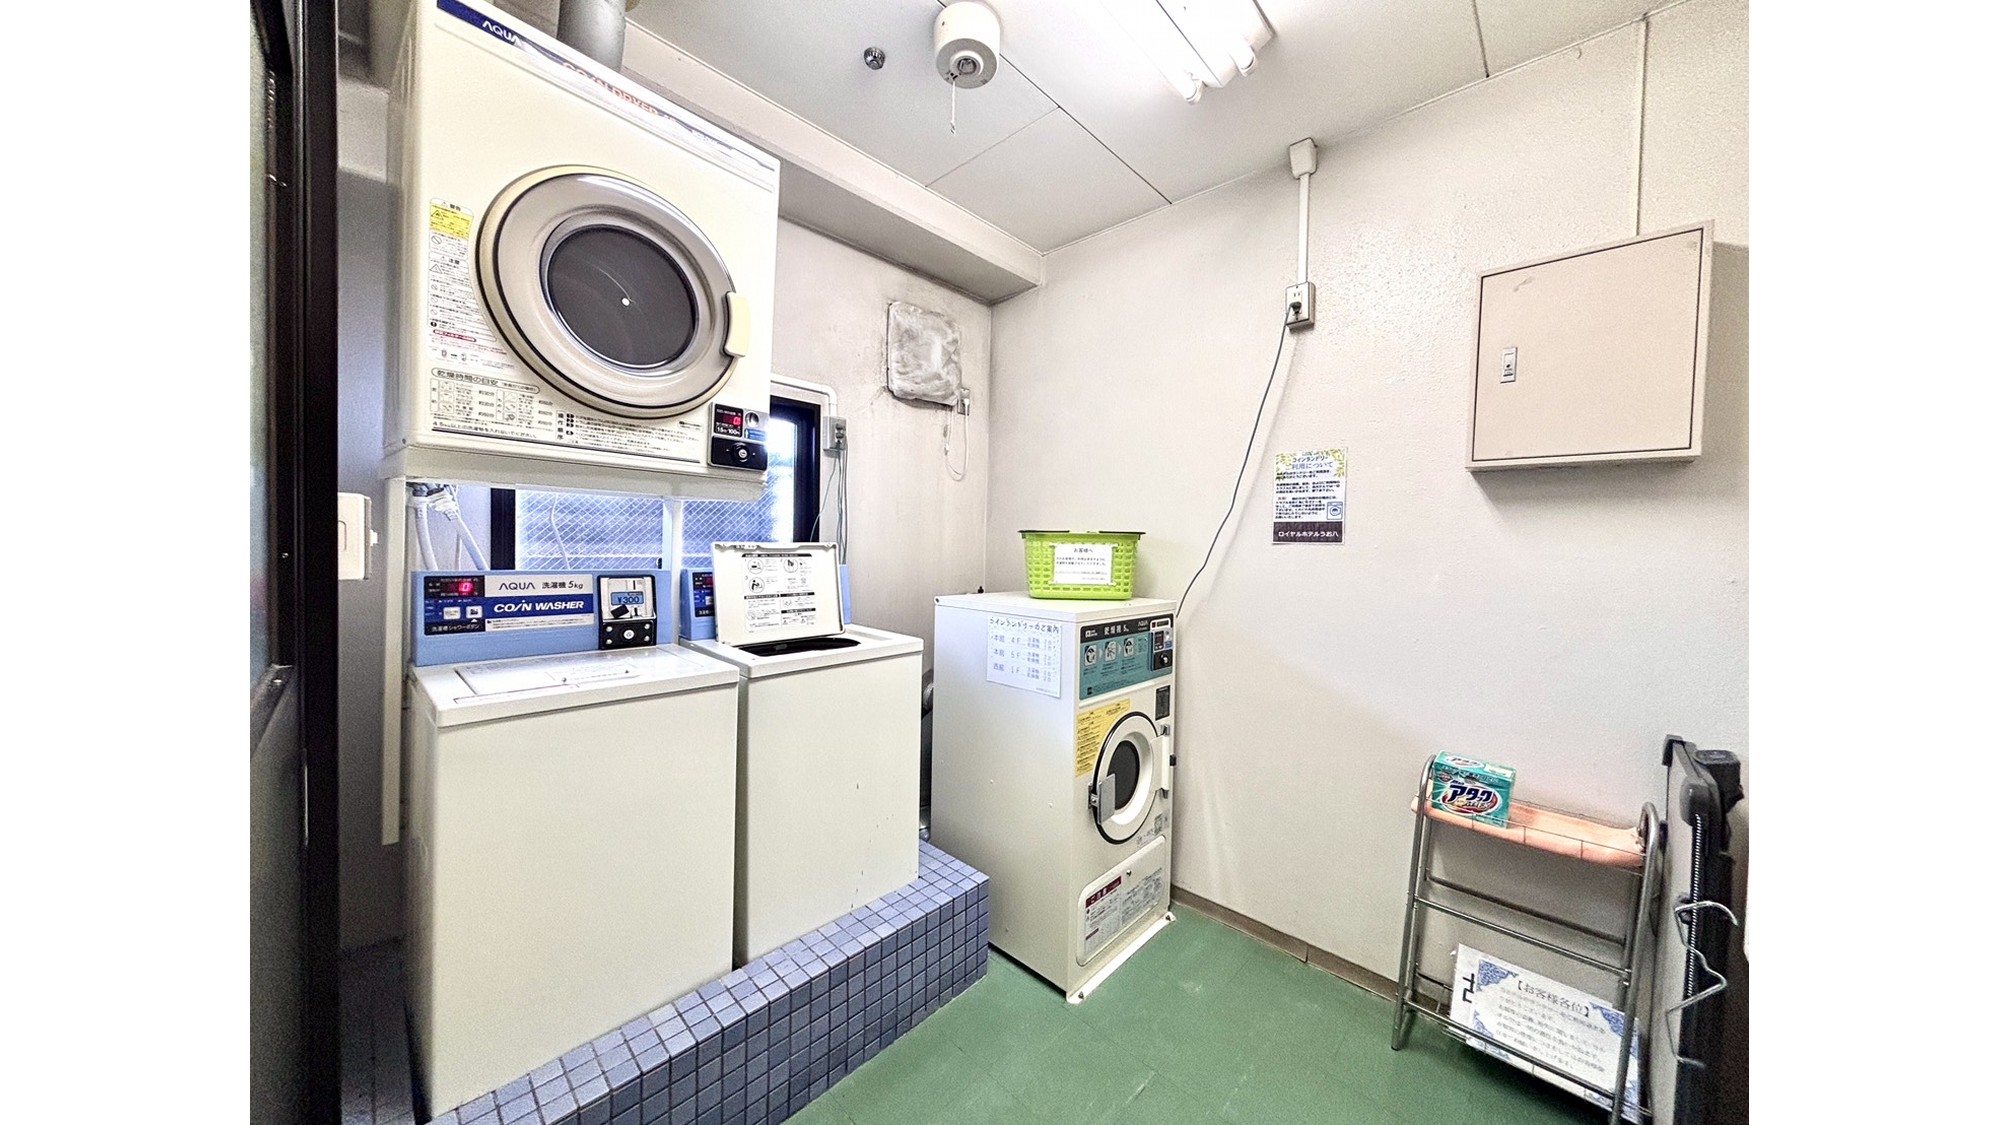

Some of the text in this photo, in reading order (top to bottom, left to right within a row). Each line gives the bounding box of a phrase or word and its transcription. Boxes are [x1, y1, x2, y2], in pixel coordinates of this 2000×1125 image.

[482, 20, 525, 46] AQUA
[462, 582, 470, 592] 0
[499, 580, 583, 591] AQUA 洗濯機 5kg
[494, 600, 584, 613] COIN WASHER
[1447, 784, 1493, 803] アタック
